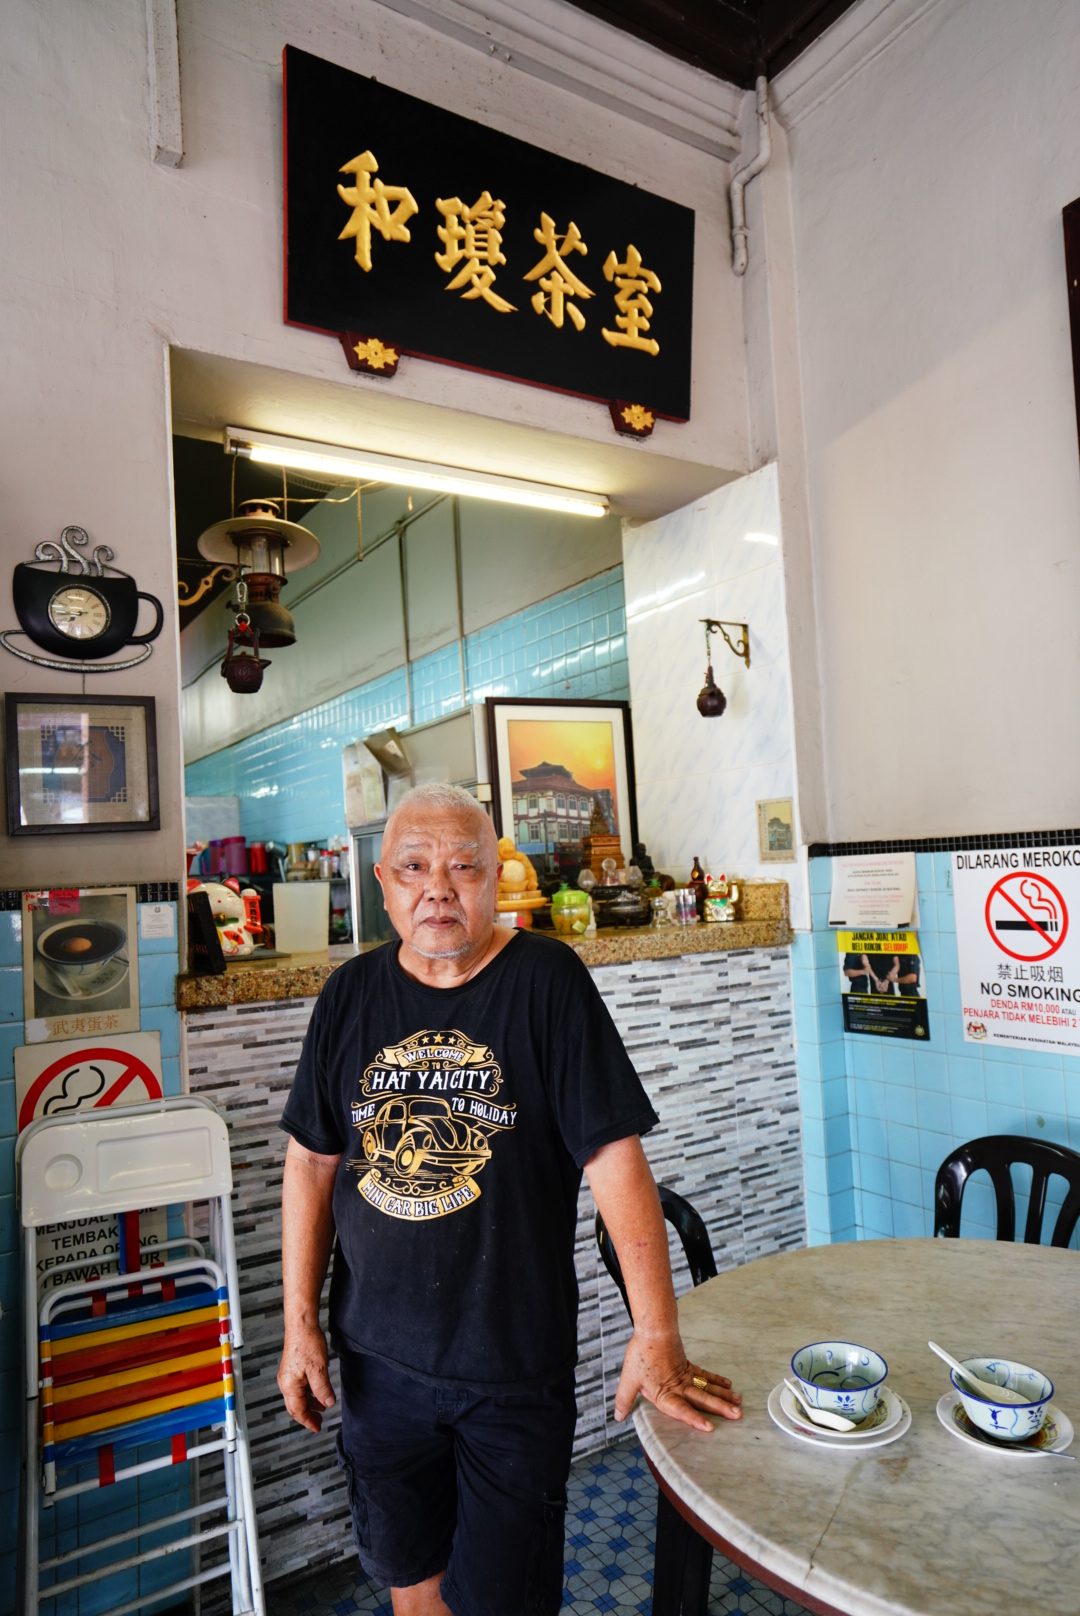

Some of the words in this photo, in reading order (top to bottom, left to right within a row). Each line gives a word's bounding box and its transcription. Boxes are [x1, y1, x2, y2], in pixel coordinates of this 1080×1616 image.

[337, 150, 662, 357] 和瓊茶室
[956, 853, 1019, 870] DILARANG
[998, 963, 1063, 983] 禁止吸烟
[980, 982, 1002, 996] NO
[1007, 984, 1080, 1003] SMOKING
[963, 1007, 1000, 1019] PENJARA
[1002, 1011, 1026, 1022] TIDAK
[1028, 1014, 1069, 1027] MELEBIHI
[1072, 1019, 1077, 1028] 2
[991, 999, 1018, 1010] DENDA
[1061, 1008, 1077, 1016] ATAU
[53, 1014, 120, 1036] 武夷蛋茶
[404, 1049, 465, 1062] WELCOME
[432, 1062, 440, 1070] TO
[371, 1071, 411, 1090] HAT
[419, 1071, 449, 1090] YAI
[450, 1070, 491, 1089] CITY
[351, 1103, 375, 1123] TIME
[452, 1097, 465, 1111] TO
[469, 1100, 518, 1125] HOLIDAY
[362, 1180, 386, 1207] MINI
[385, 1197, 411, 1216] CAR
[414, 1200, 439, 1217] BIG
[439, 1185, 475, 1211] LIFE
[53, 1262, 111, 1286] BAWAH
